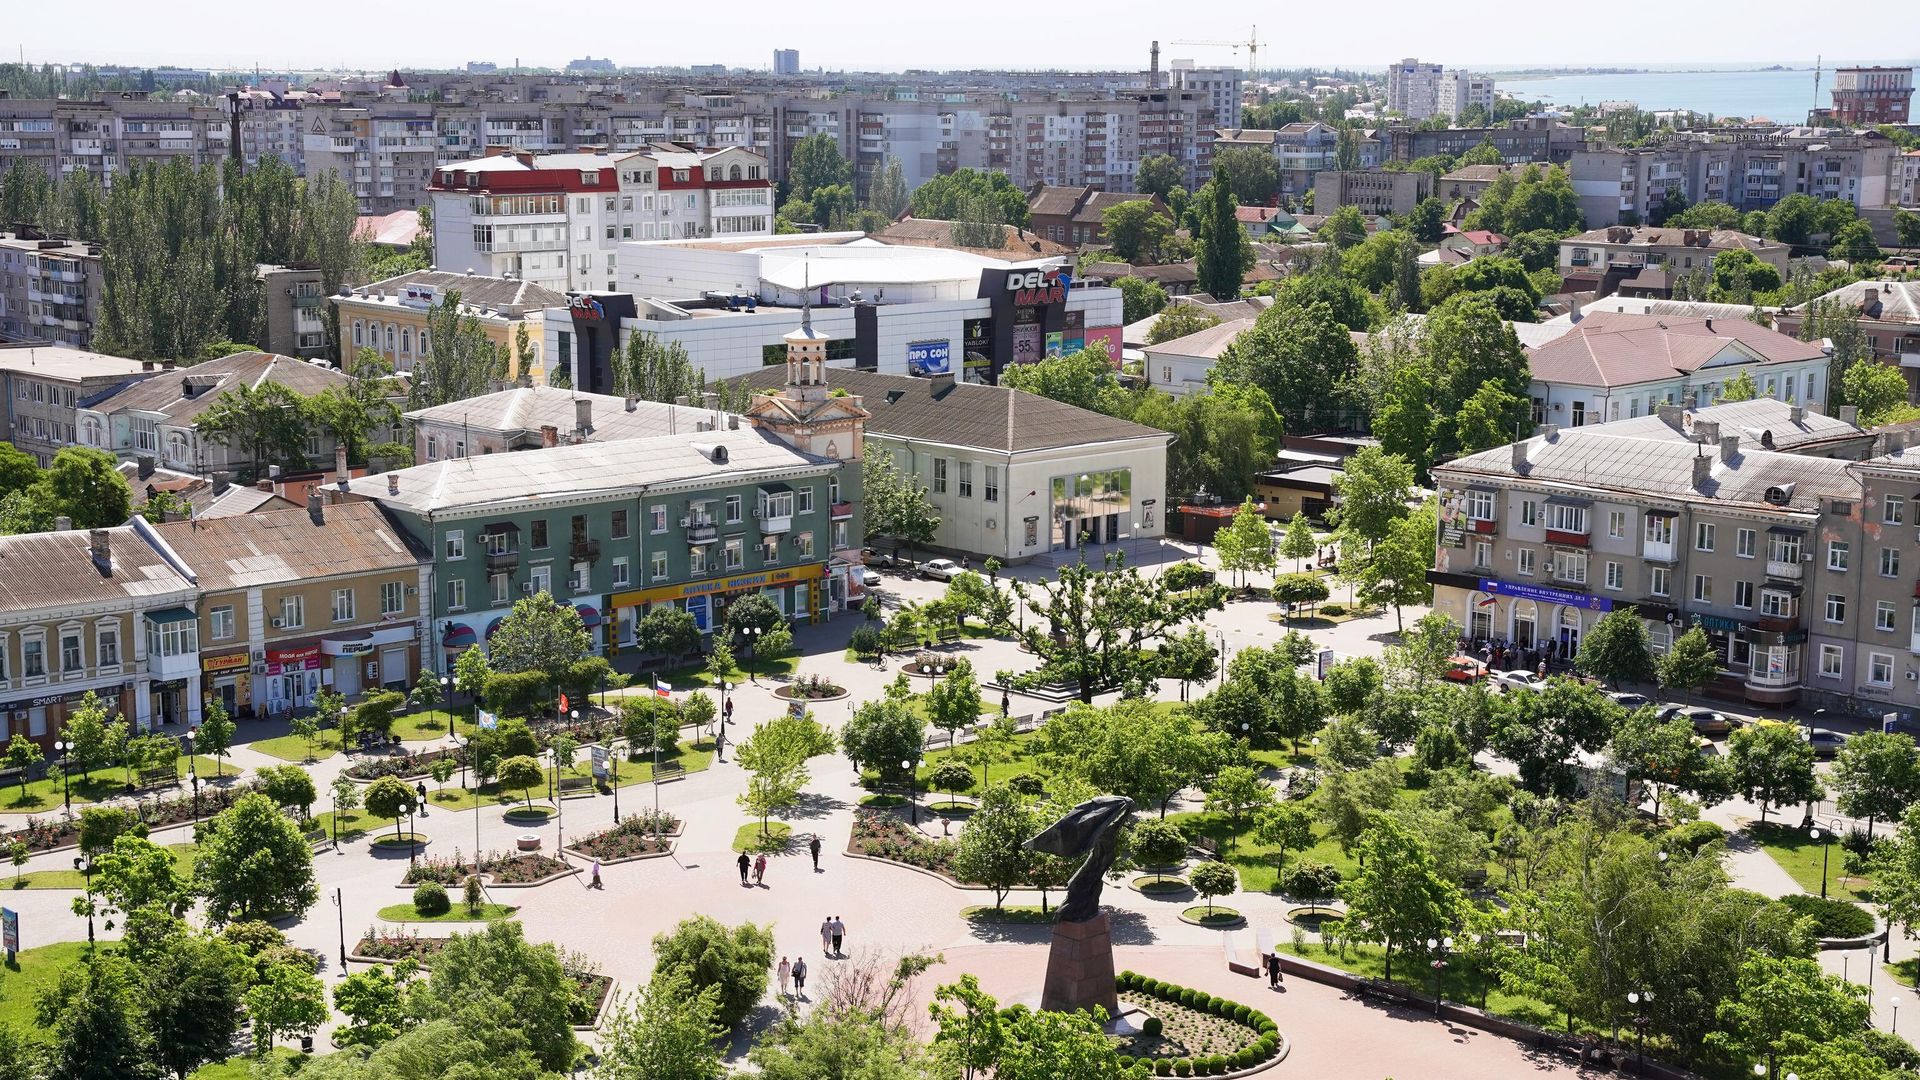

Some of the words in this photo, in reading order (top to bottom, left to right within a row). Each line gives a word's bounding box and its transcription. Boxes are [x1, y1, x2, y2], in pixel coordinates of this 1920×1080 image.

[1006, 272, 1048, 290] DEL
[563, 294, 588, 308] DEL
[1014, 287, 1064, 305] MAR
[571, 307, 600, 321] MAR
[909, 350, 927, 360] ПРО
[930, 348, 948, 358] СОН
[1504, 584, 1539, 594] УПРАВЛЕНИЕ
[1704, 618, 1735, 631] ОПТИКА
[32, 695, 62, 706] SMART
